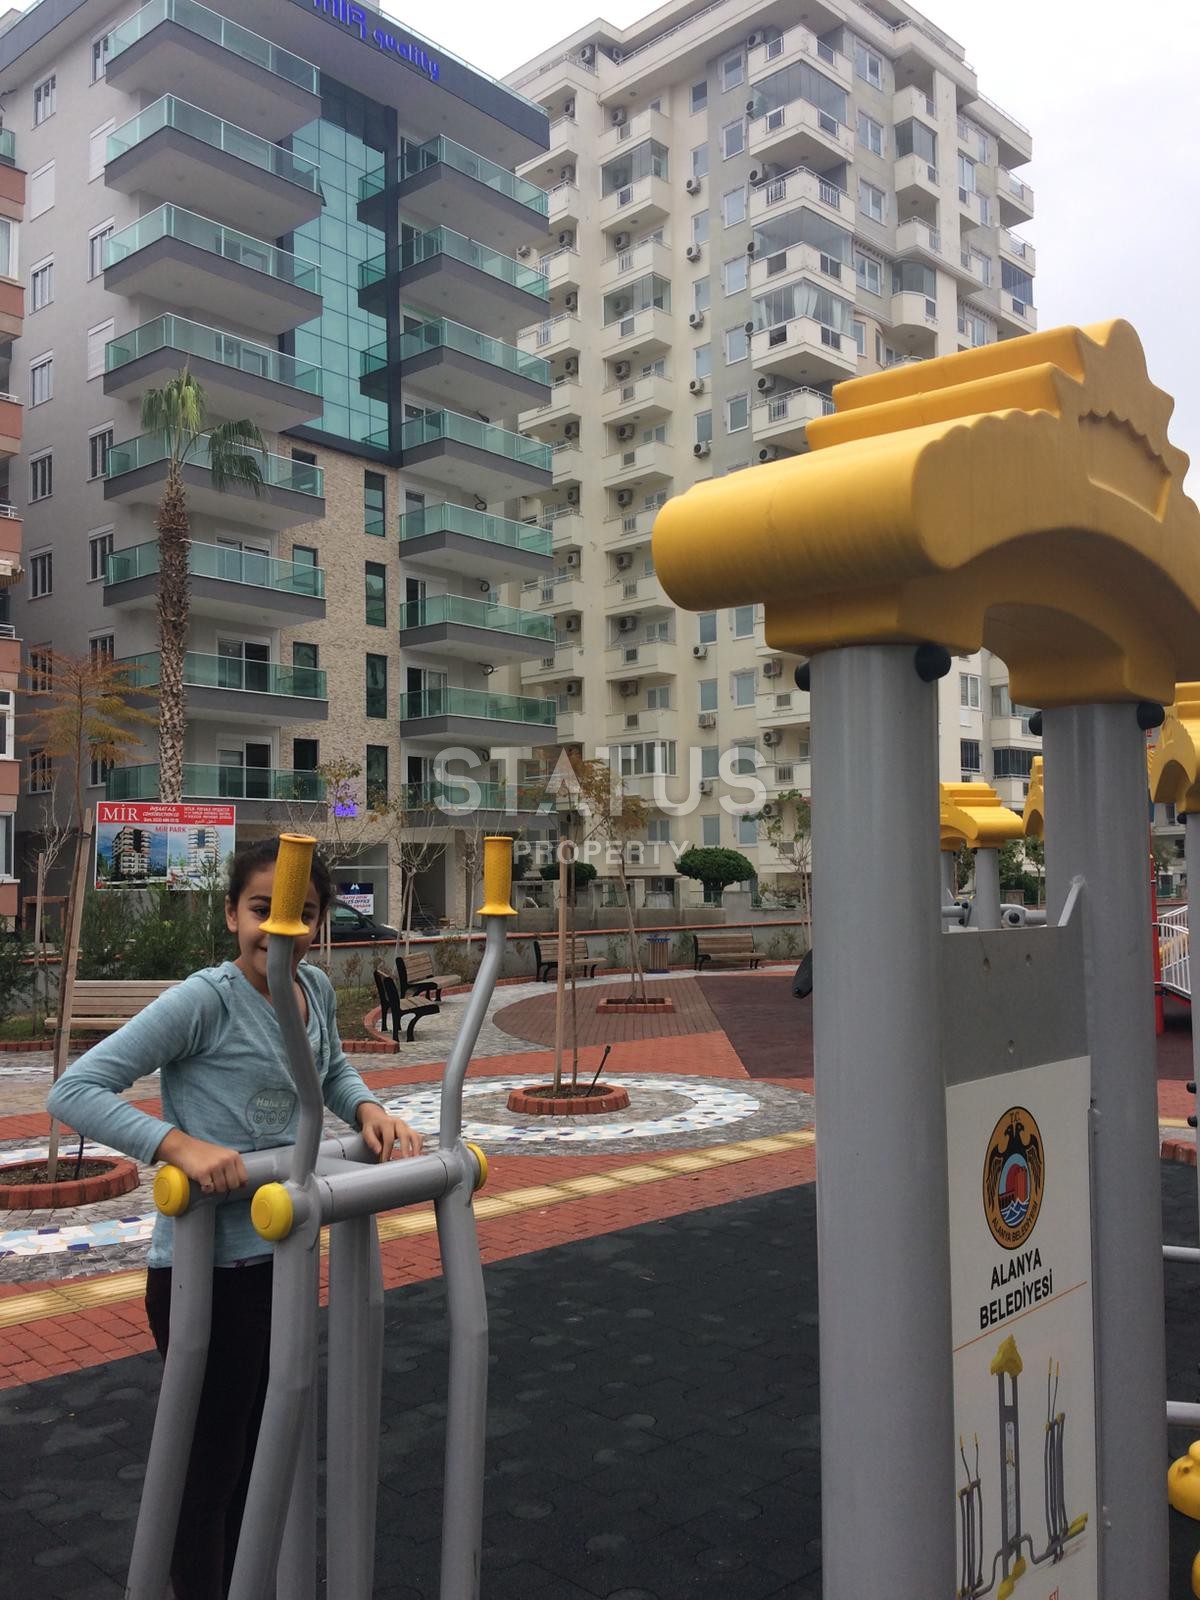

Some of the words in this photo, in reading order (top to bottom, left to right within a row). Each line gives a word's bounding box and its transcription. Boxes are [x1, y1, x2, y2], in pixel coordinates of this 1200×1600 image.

[372, 28, 440, 81] quality
[103, 804, 139, 821] MİR
[991, 1248, 1042, 1290] ALANYA
[980, 1268, 1053, 1330] BELEDİYESİ
